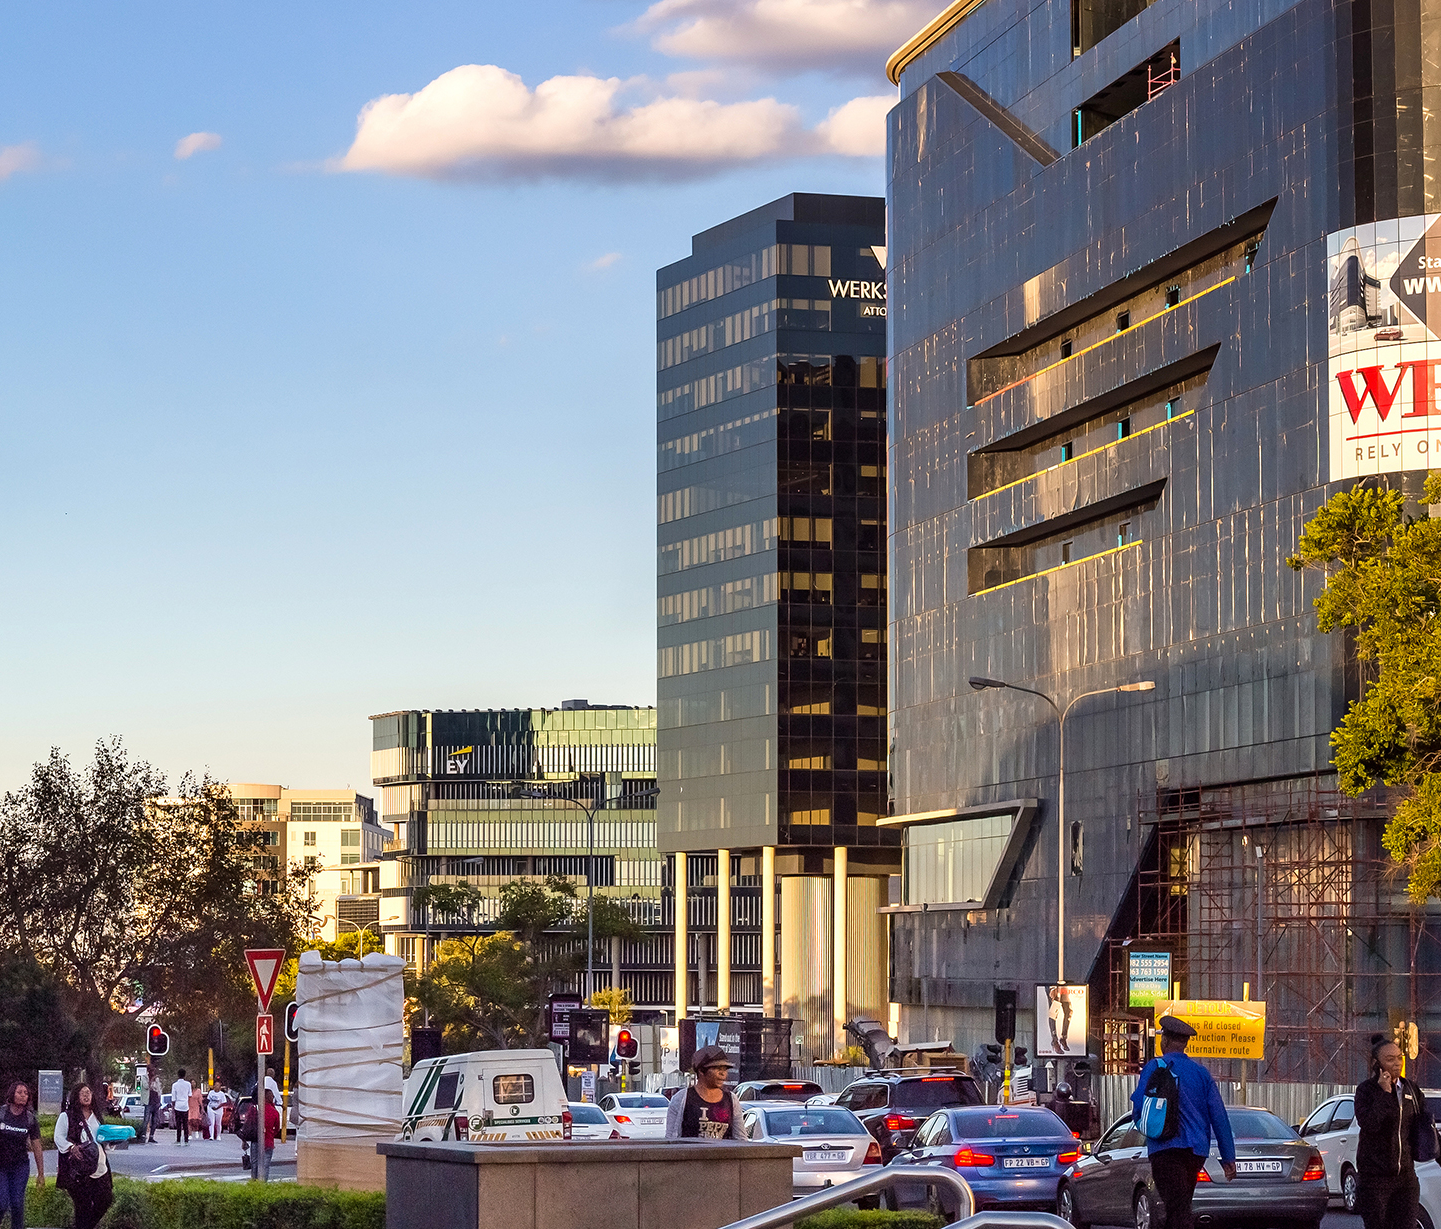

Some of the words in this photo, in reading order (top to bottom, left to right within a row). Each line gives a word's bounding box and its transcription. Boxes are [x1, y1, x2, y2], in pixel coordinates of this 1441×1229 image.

[863, 306, 887, 317] ATTO
[1355, 442, 1401, 461] RELY
[446, 759, 469, 774] EY
[1141, 968, 1152, 976] 763
[1186, 1002, 1232, 1014] DETOUR
[1203, 1021, 1213, 1030] Rd
[1216, 1021, 1241, 1031] closed
[1189, 1033, 1228, 1042] struction.
[1231, 1033, 1256, 1043] Please
[1185, 1044, 1227, 1054] alternative
[1229, 1046, 1250, 1055] route
[699, 1107, 709, 1122] I
[1016, 1159, 1024, 1167] 22
[1040, 1158, 1049, 1166] GP
[1244, 1163, 1254, 1171] 78
[1271, 1162, 1280, 1171] GP
